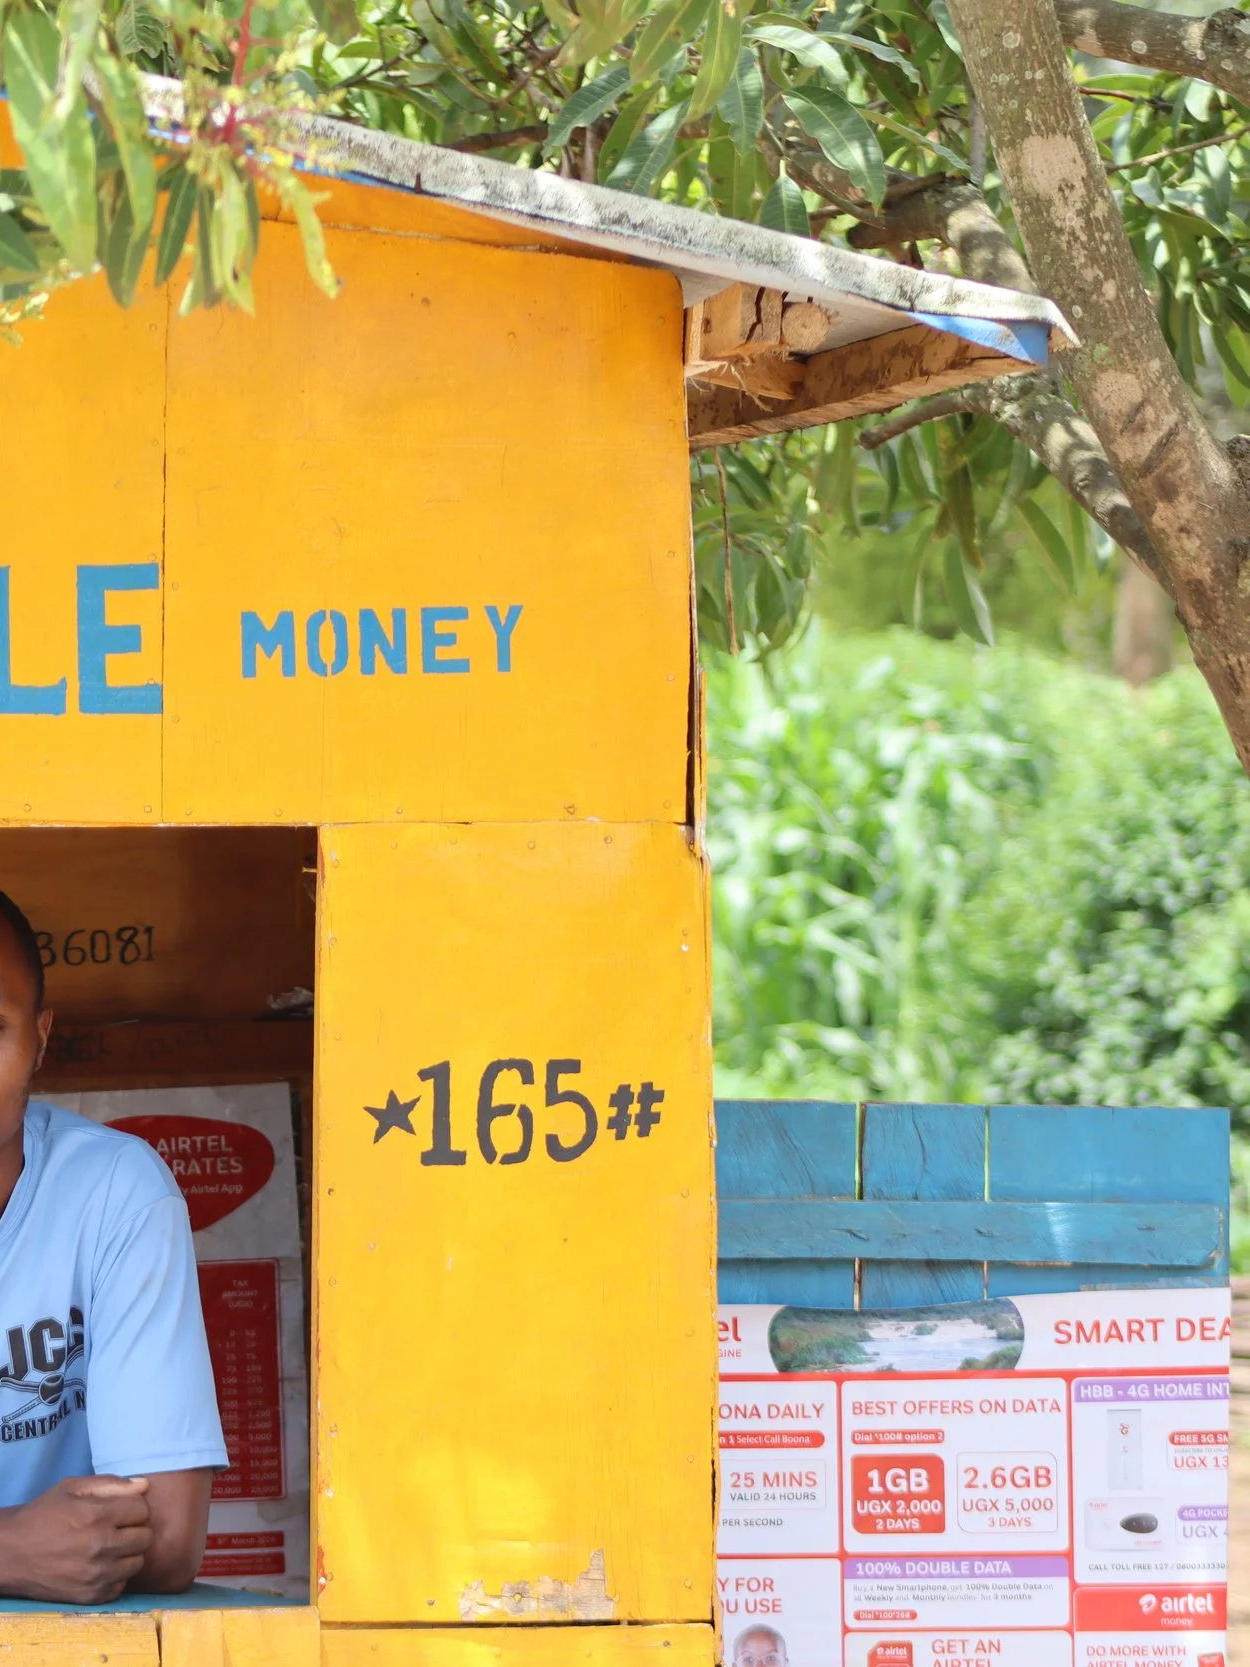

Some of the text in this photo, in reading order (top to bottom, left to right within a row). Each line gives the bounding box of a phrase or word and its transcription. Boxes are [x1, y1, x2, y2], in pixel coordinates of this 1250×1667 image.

[241, 605, 524, 678] MONEY
[156, 1135, 233, 1153] AIRTEL
[173, 1156, 244, 1175] RATES
[190, 1184, 219, 1193] Airtel
[221, 1183, 243, 1195] App
[1054, 1317, 1165, 1345] SMART
[1080, 1384, 1114, 1398] HBB
[1127, 1384, 1150, 1398] 4G
[1154, 1382, 1202, 1397] HOME
[767, 1402, 825, 1419] DAILY
[851, 1398, 1062, 1415] BEST OFFERS ON DATA
[736, 1433, 762, 1444] Select
[763, 1433, 780, 1444] Call
[782, 1434, 810, 1444] Boona
[854, 1431, 872, 1441] Dial
[904, 1432, 934, 1443] option
[937, 1431, 943, 1440] 2
[1174, 1433, 1198, 1443] FREE
[1174, 1455, 1207, 1469] UGX
[730, 1470, 818, 1488] 25 MINS
[867, 1467, 930, 1494] 1GB
[964, 1465, 1052, 1490] 2.6GB
[730, 1491, 817, 1501] VALID 24 HOURS
[856, 1499, 942, 1516] UGX 2,000
[962, 1497, 1054, 1514] UGX 5,000
[1182, 1508, 1196, 1518] 4G
[722, 1517, 783, 1527] PER SECOND
[876, 1518, 920, 1529] 2 DAYS
[988, 1516, 1031, 1527] 3 DAYS
[1182, 1524, 1218, 1539] UGX
[856, 1560, 1012, 1575] 100% DOUBLE DATA
[1088, 1563, 1107, 1571] CALL
[1111, 1563, 1130, 1571] TOLL
[1132, 1563, 1151, 1571] FREE
[735, 1577, 775, 1593] FOR
[877, 1583, 894, 1592] New
[966, 1583, 990, 1591] 100%
[992, 1583, 1021, 1591] Double
[1023, 1582, 1042, 1590] Data
[745, 1598, 782, 1614] USE
[864, 1593, 892, 1604] Weekly
[895, 1594, 908, 1602] and
[912, 1593, 945, 1603] Monthly
[1001, 1593, 1032, 1601] months
[1161, 1592, 1214, 1614] airtel
[859, 1611, 874, 1620] Dial
[1161, 1617, 1193, 1627] money
[884, 1646, 908, 1656] airtel
[931, 1639, 1001, 1655] GET AN
[1086, 1644, 1186, 1657] DO MORE WITH
